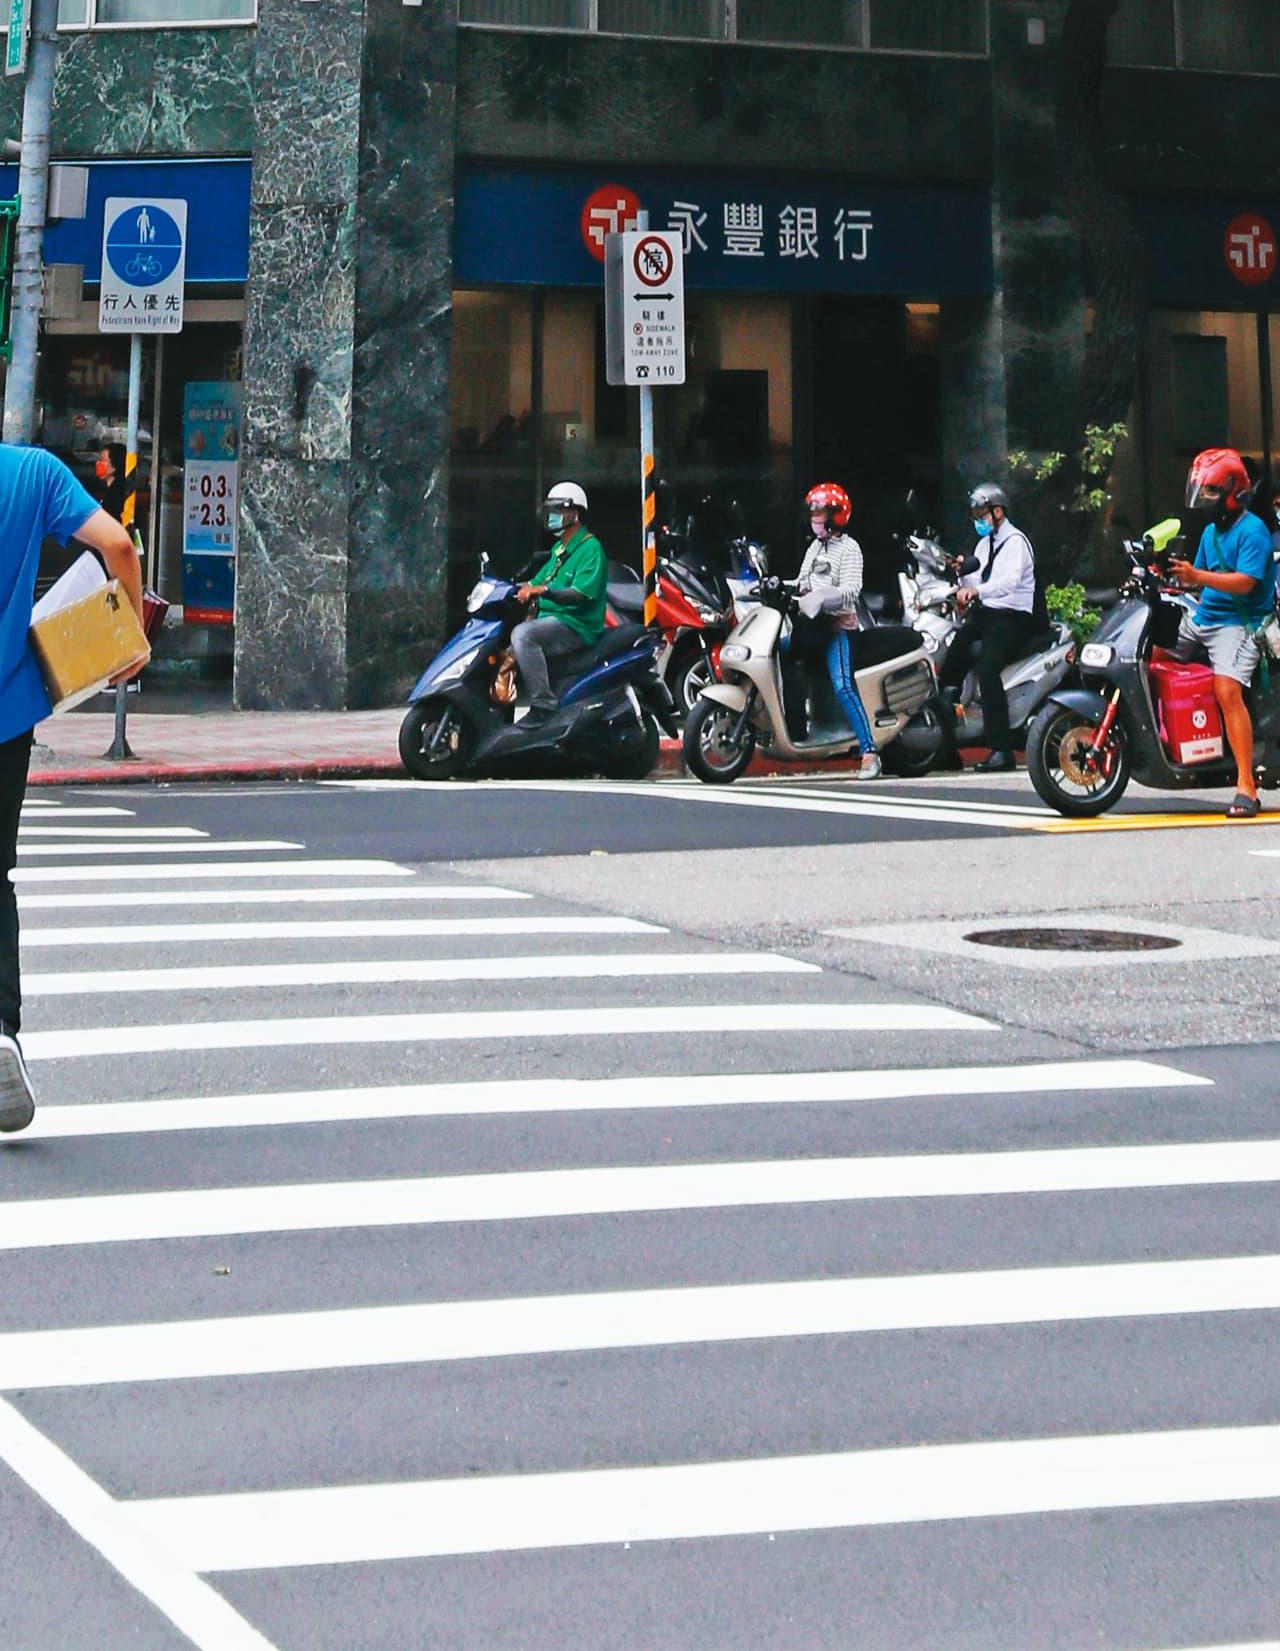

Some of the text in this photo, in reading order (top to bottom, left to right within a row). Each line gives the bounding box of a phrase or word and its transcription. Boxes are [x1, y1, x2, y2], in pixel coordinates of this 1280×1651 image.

[668, 201, 873, 261] 永豐銀行
[104, 294, 180, 311] 行人優先
[656, 365, 675, 377] 110
